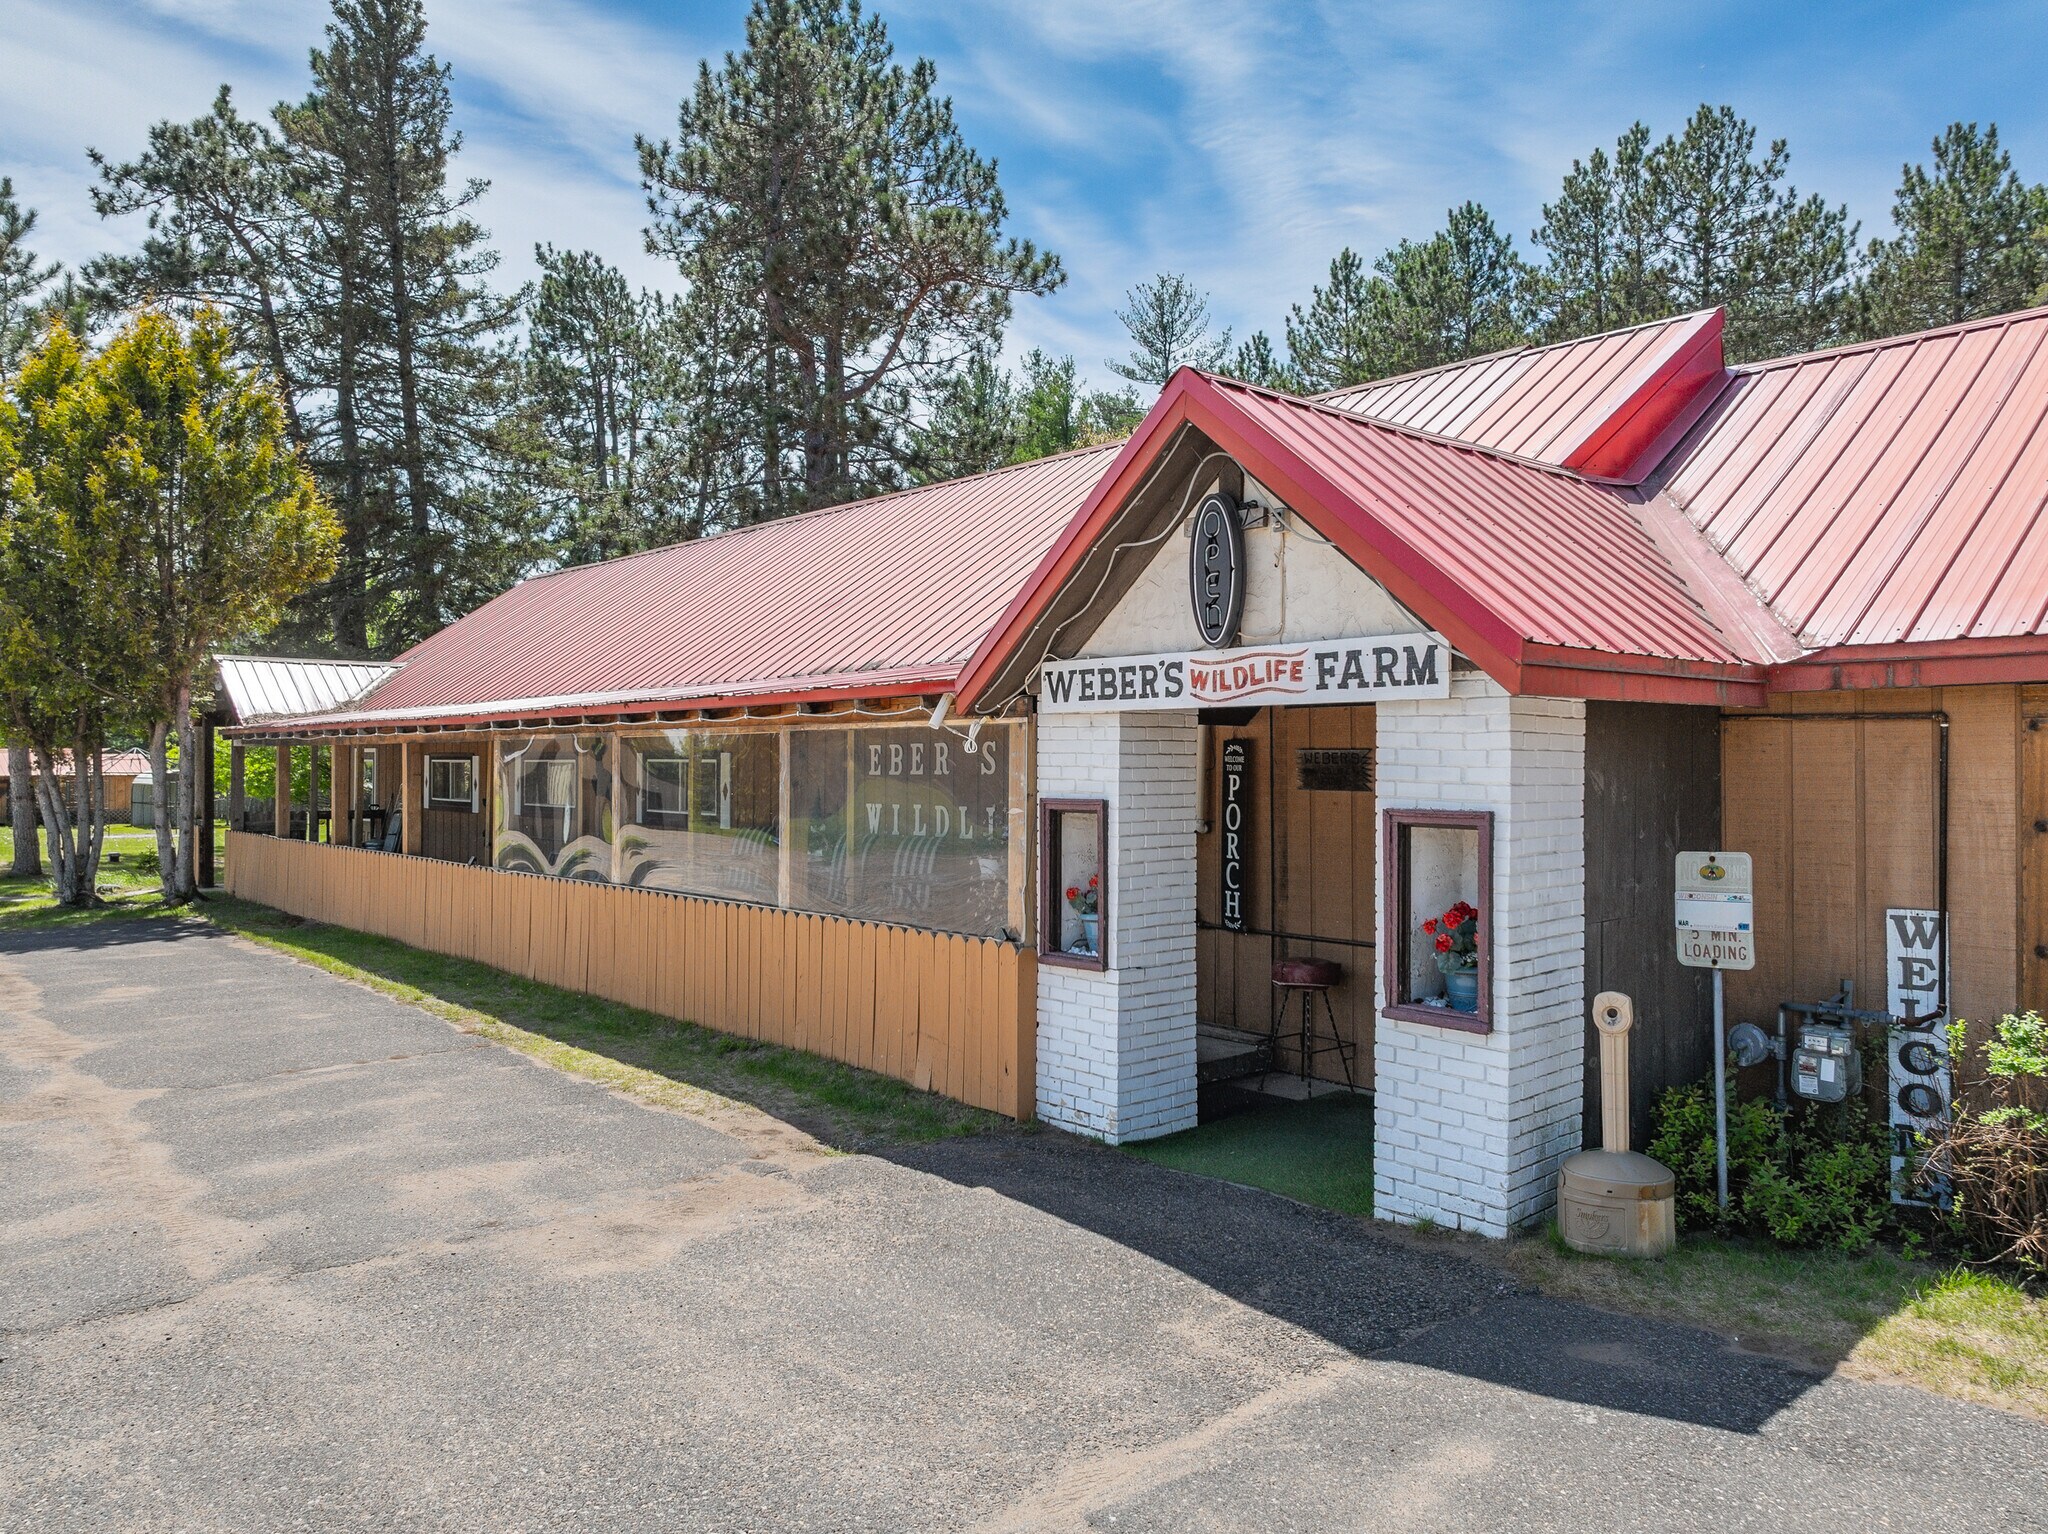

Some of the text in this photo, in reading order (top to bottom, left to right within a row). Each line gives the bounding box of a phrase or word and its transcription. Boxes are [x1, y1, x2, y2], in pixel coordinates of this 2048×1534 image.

[1044, 644, 1439, 703] WEBER'S WILDLIFE FARM
[1224, 755, 1245, 763] WELCOME
[1226, 764, 1242, 772] TO OUR
[1225, 774, 1242, 918] PORCH
[1684, 943, 1747, 961] LOADING
